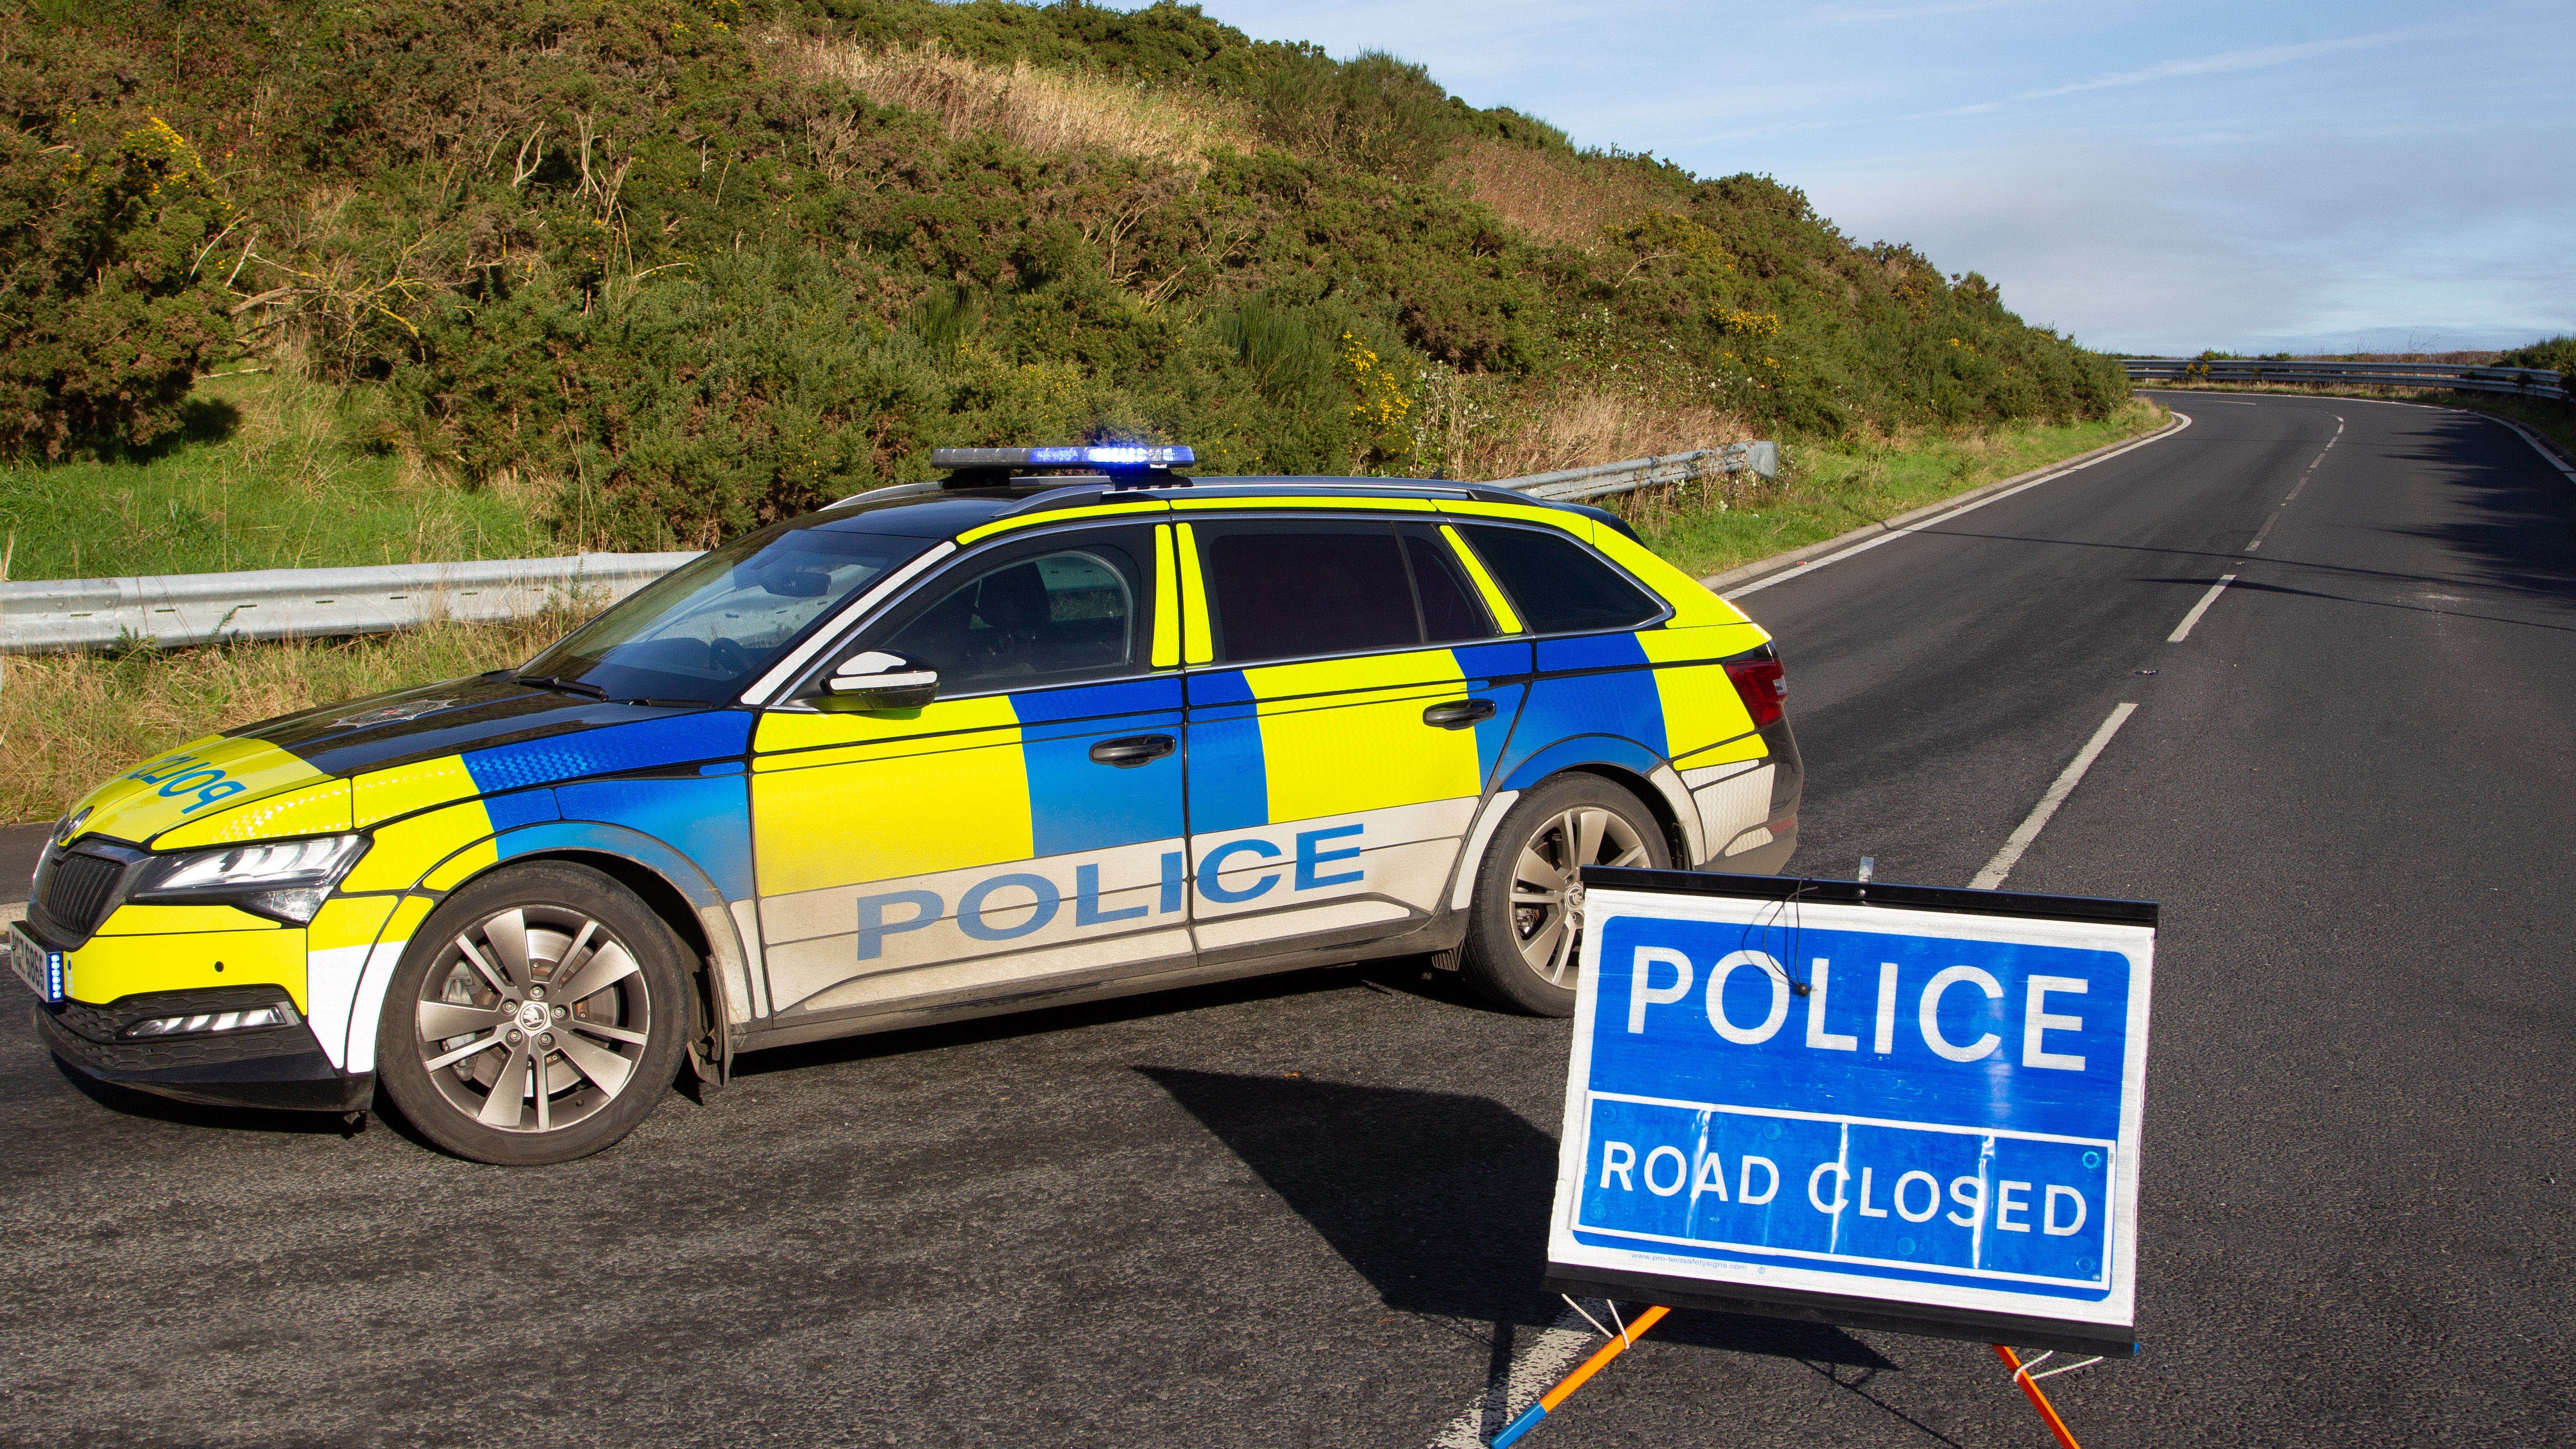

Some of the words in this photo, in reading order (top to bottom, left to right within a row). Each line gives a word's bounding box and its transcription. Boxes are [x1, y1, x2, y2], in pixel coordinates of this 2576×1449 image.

[857, 823, 1364, 961] POLICE
[1627, 945, 2090, 1071] POLICE
[1599, 1141, 1779, 1206] ROAD
[1807, 1162, 2087, 1236] CLOSED
[1631, 1252, 1747, 1271] www.pro-tectsafetysigns.com
